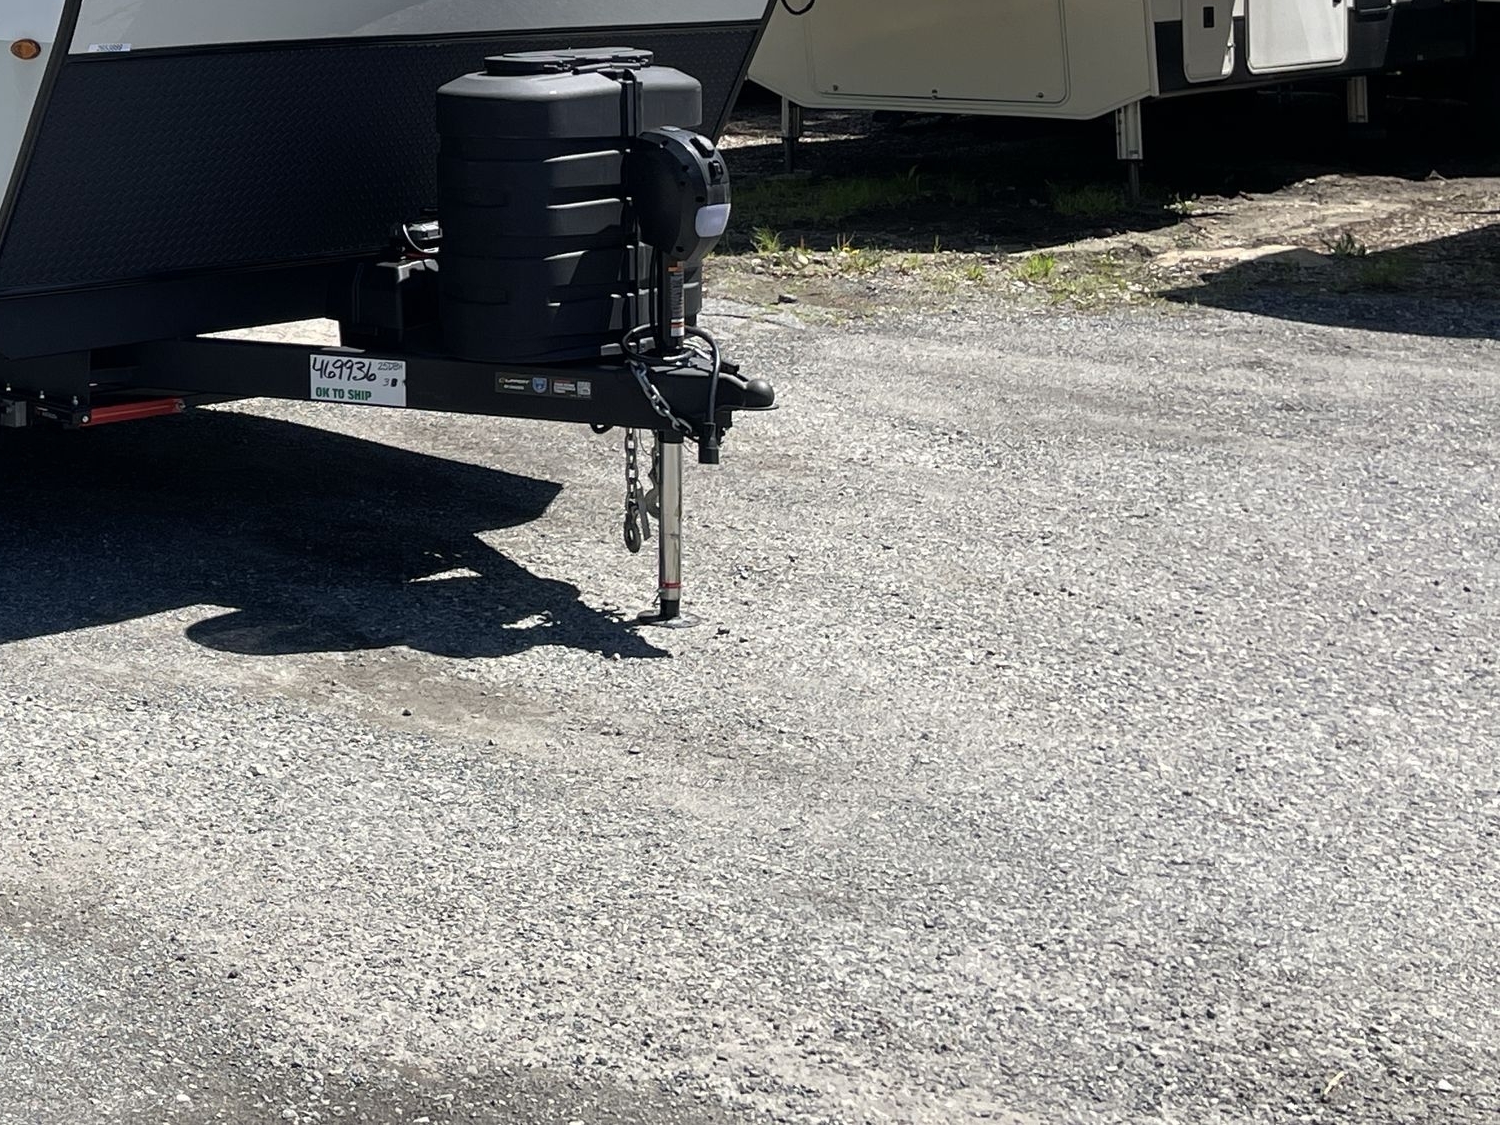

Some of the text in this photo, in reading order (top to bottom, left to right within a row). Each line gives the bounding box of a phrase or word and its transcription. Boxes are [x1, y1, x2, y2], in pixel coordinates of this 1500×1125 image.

[312, 357, 377, 382] 469936
[315, 386, 372, 401] OK TO SHIP
